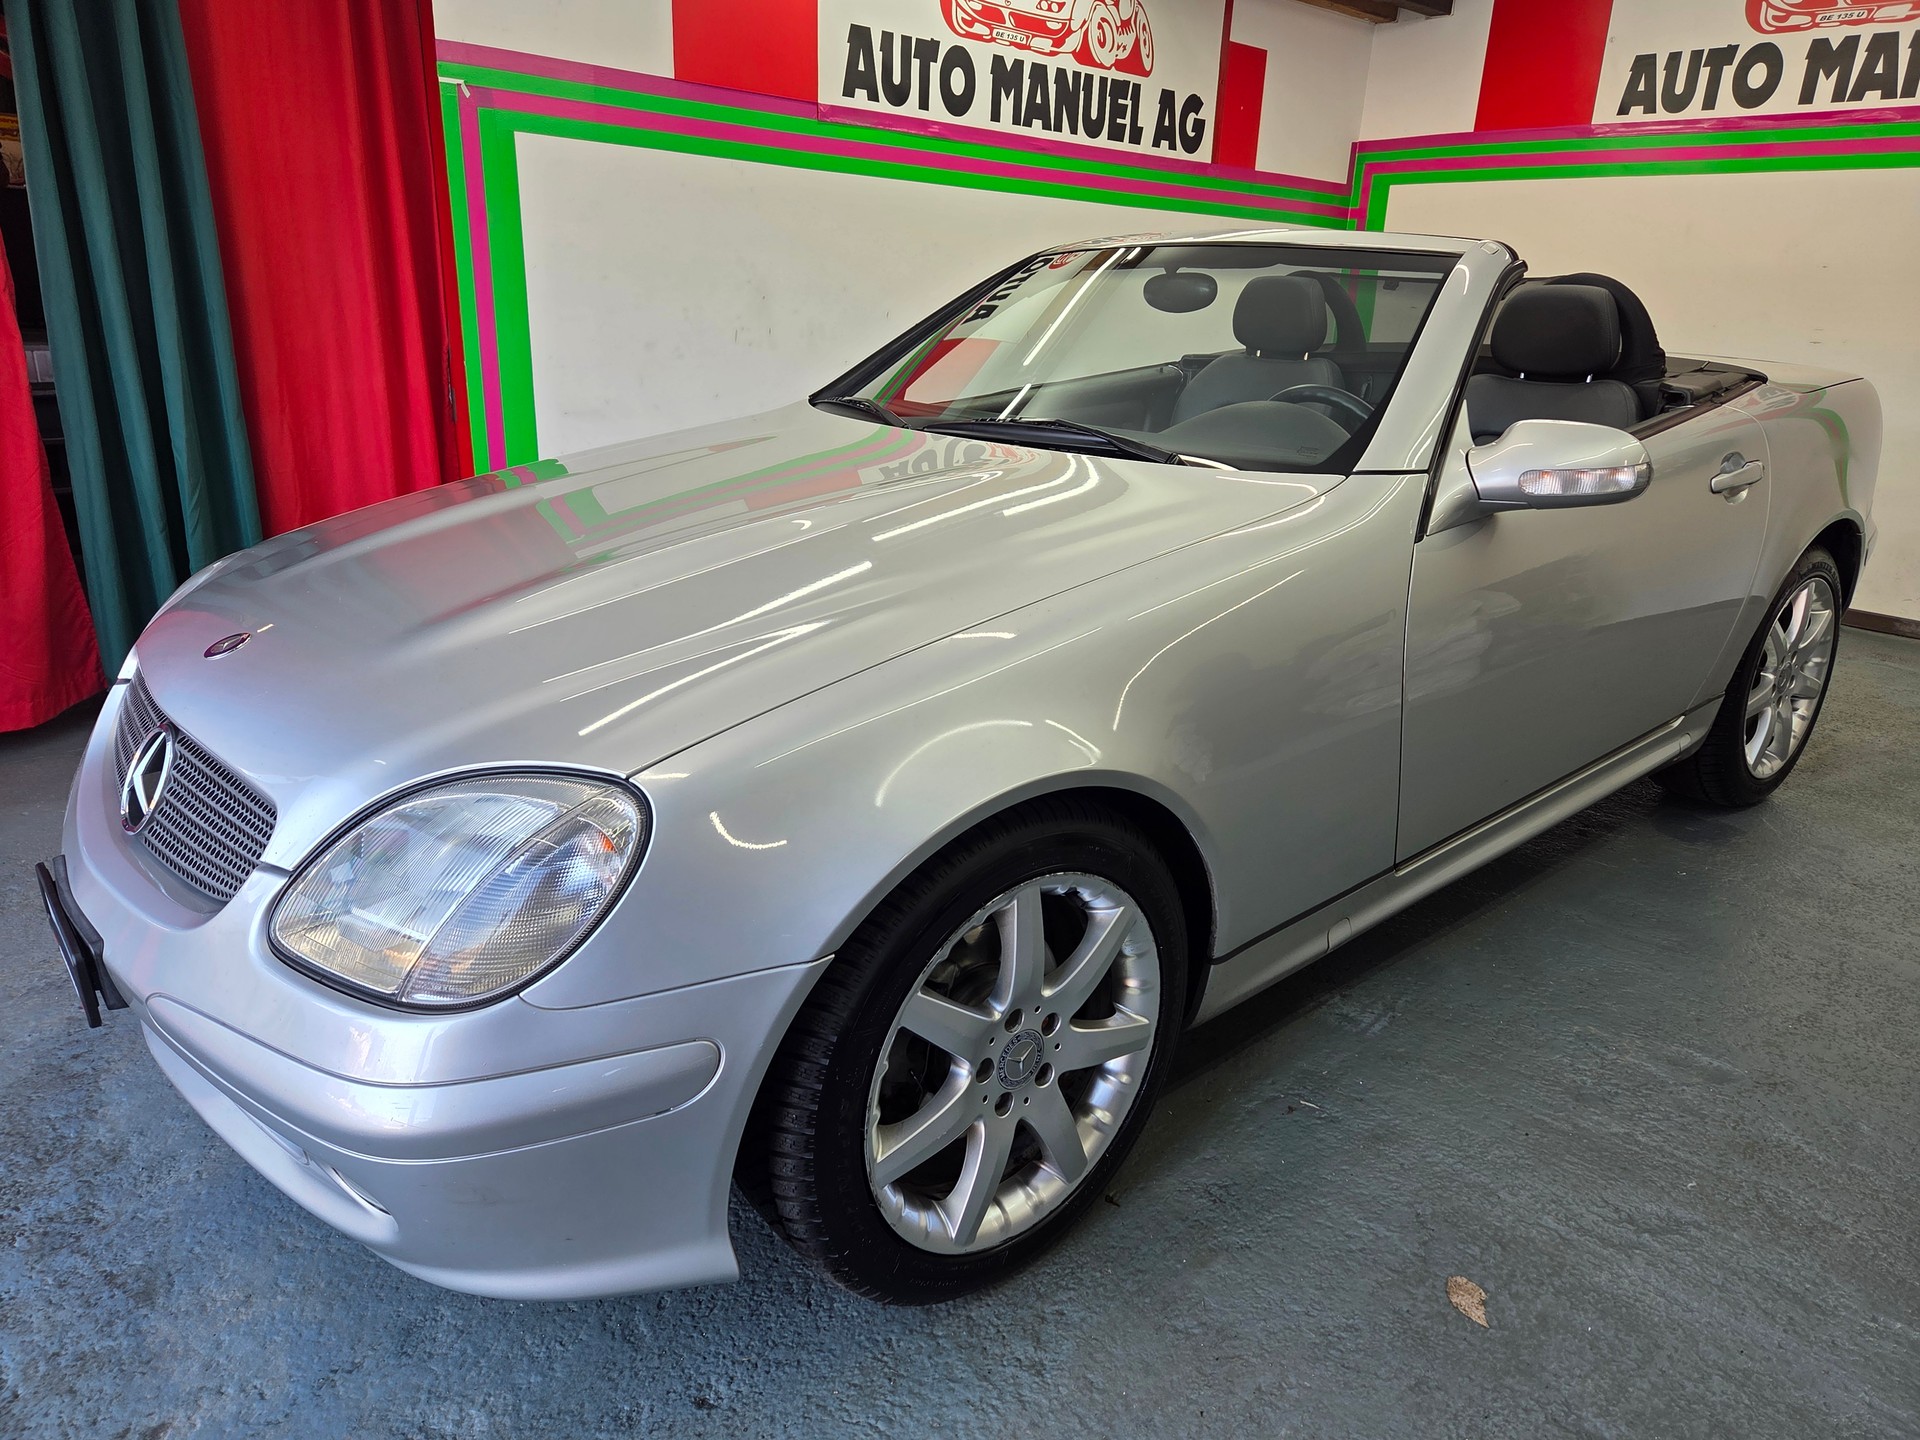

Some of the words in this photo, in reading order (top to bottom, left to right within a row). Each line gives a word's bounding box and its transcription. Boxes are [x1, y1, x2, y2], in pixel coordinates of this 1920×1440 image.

[1006, 33, 1018, 41] 135
[1837, 12, 1855, 20] 135
[842, 23, 976, 117] AUTO
[990, 54, 1144, 146] MANUEL
[1152, 88, 1206, 154] AG
[1616, 41, 1784, 116] AUTO
[999, 1036, 1019, 1079] MERCEDES
